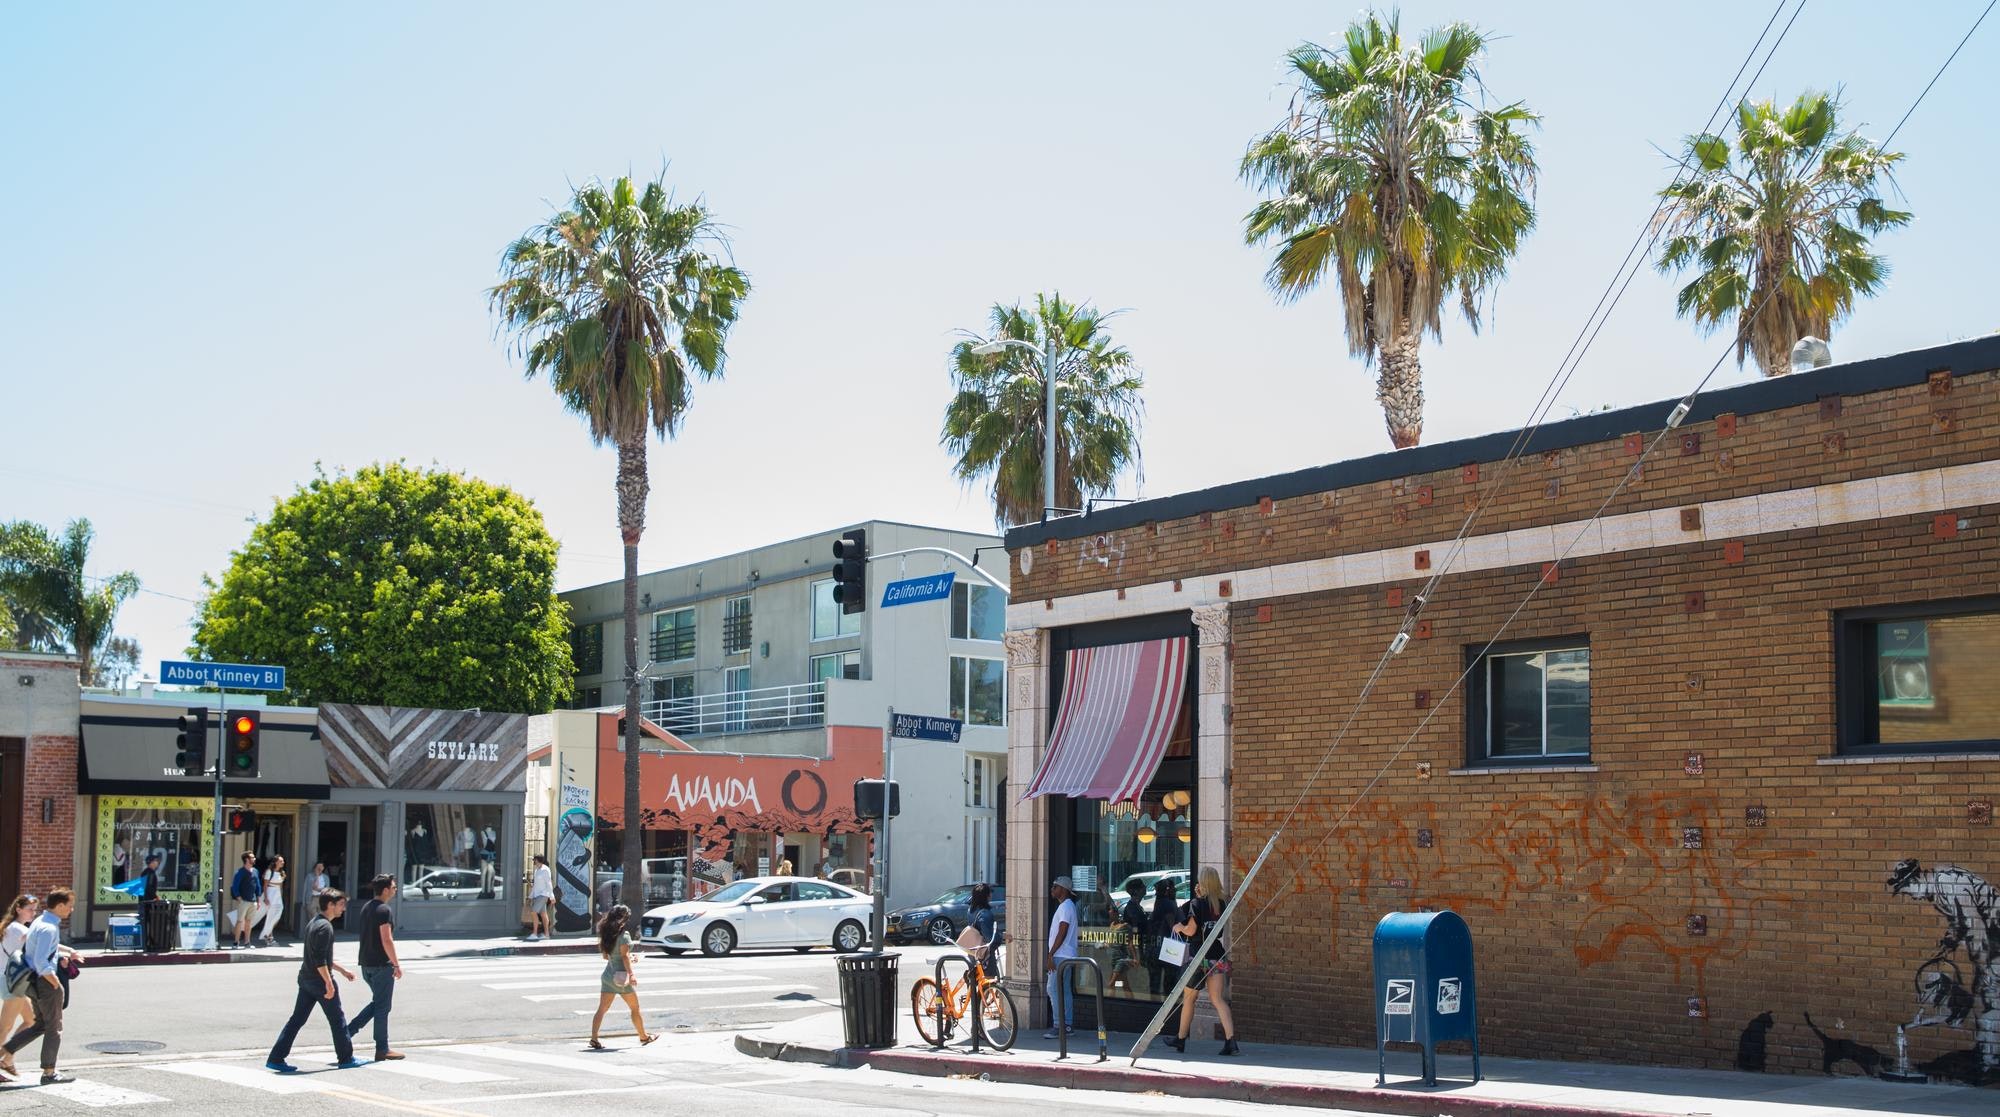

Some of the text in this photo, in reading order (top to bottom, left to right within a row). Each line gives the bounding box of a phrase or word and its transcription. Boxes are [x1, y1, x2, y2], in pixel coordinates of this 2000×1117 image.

[887, 579, 949, 600] California Av
[167, 666, 208, 680] Abbot
[213, 668, 260, 685] Kinney
[264, 671, 278, 684] Bl
[896, 715, 955, 735] Abbot Kinney
[896, 728, 910, 737] 1300
[912, 728, 917, 737] S
[428, 741, 499, 761] SKYLARK
[664, 773, 762, 814] ANANDA
[1081, 931, 1129, 945] HANDMADE
